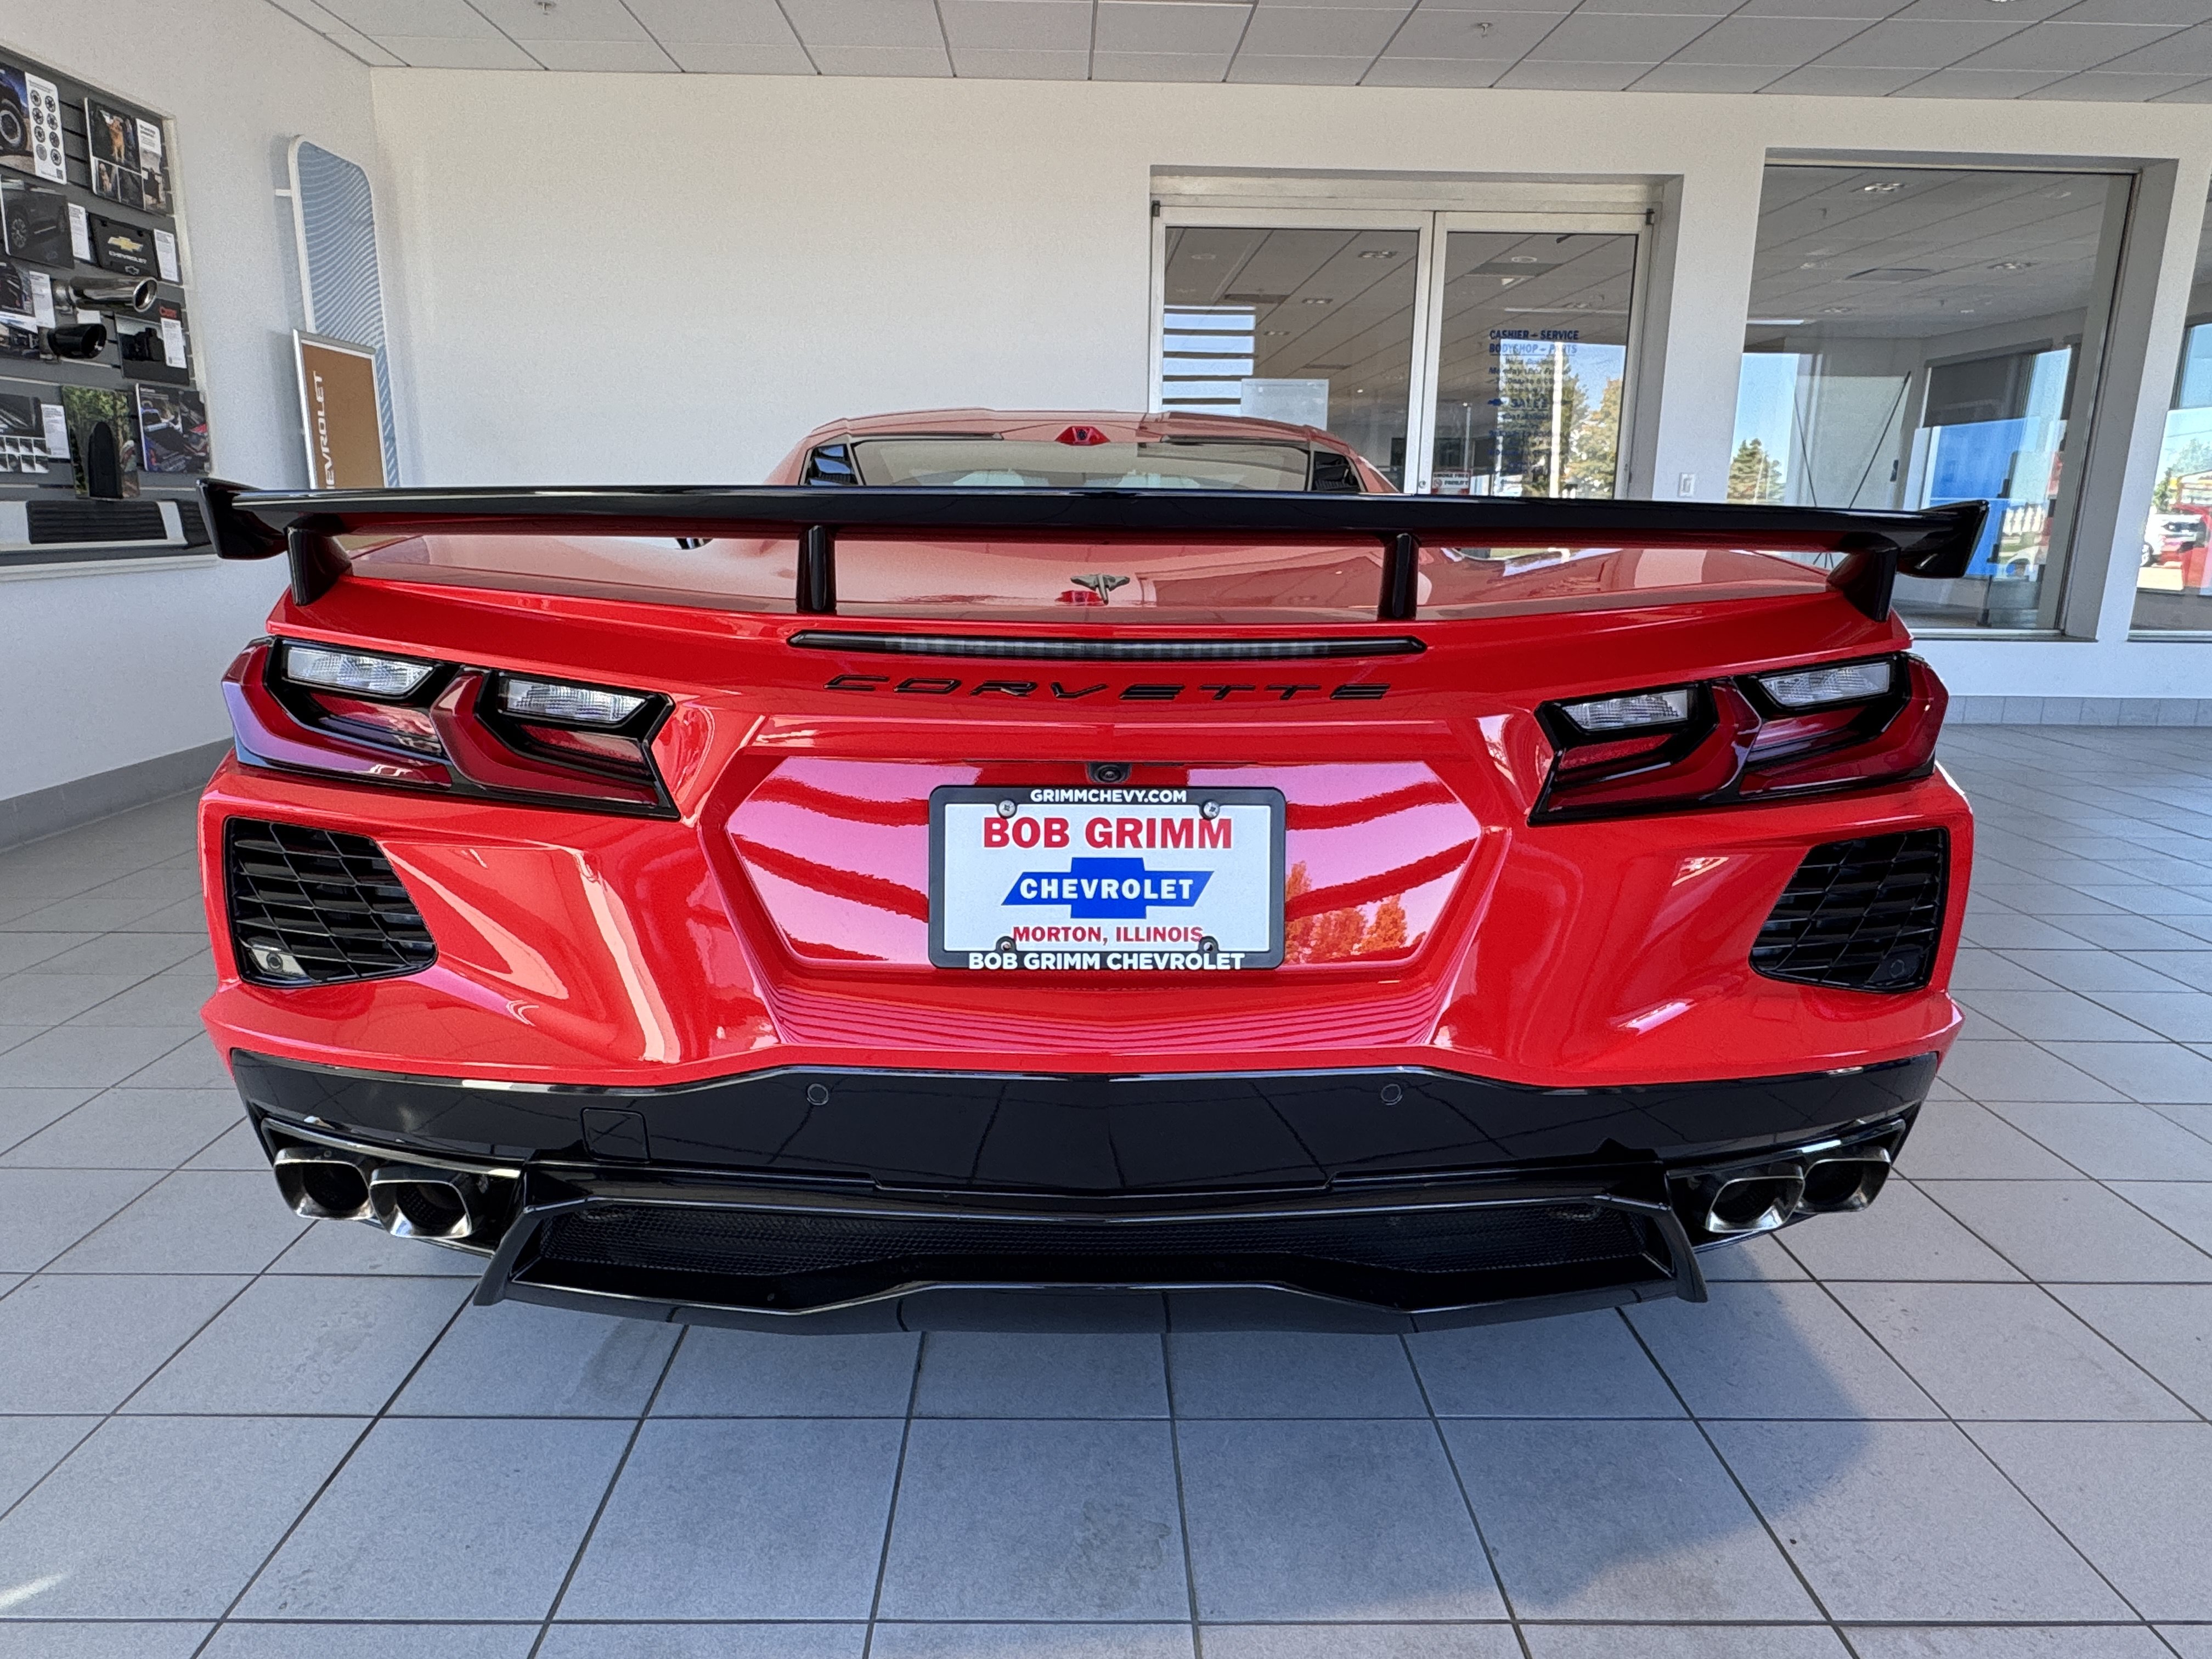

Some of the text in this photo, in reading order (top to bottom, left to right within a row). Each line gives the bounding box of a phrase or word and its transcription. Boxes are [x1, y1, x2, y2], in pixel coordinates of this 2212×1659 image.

[1489, 330, 1580, 340] CASHIER SERVICE
[1549, 344, 1578, 354] PRTS
[313, 370, 335, 489] EVROLET
[823, 674, 1391, 701] CORVETTE
[1030, 789, 1187, 803] GRIMMCHEVY.COM
[983, 817, 1232, 849] BOB GRIMM
[1019, 878, 1194, 900] CHEVROLET
[1012, 926, 1204, 946] MORTON, ILLINOIS
[968, 952, 1245, 970] BOB GRIMM CHEVROLET
